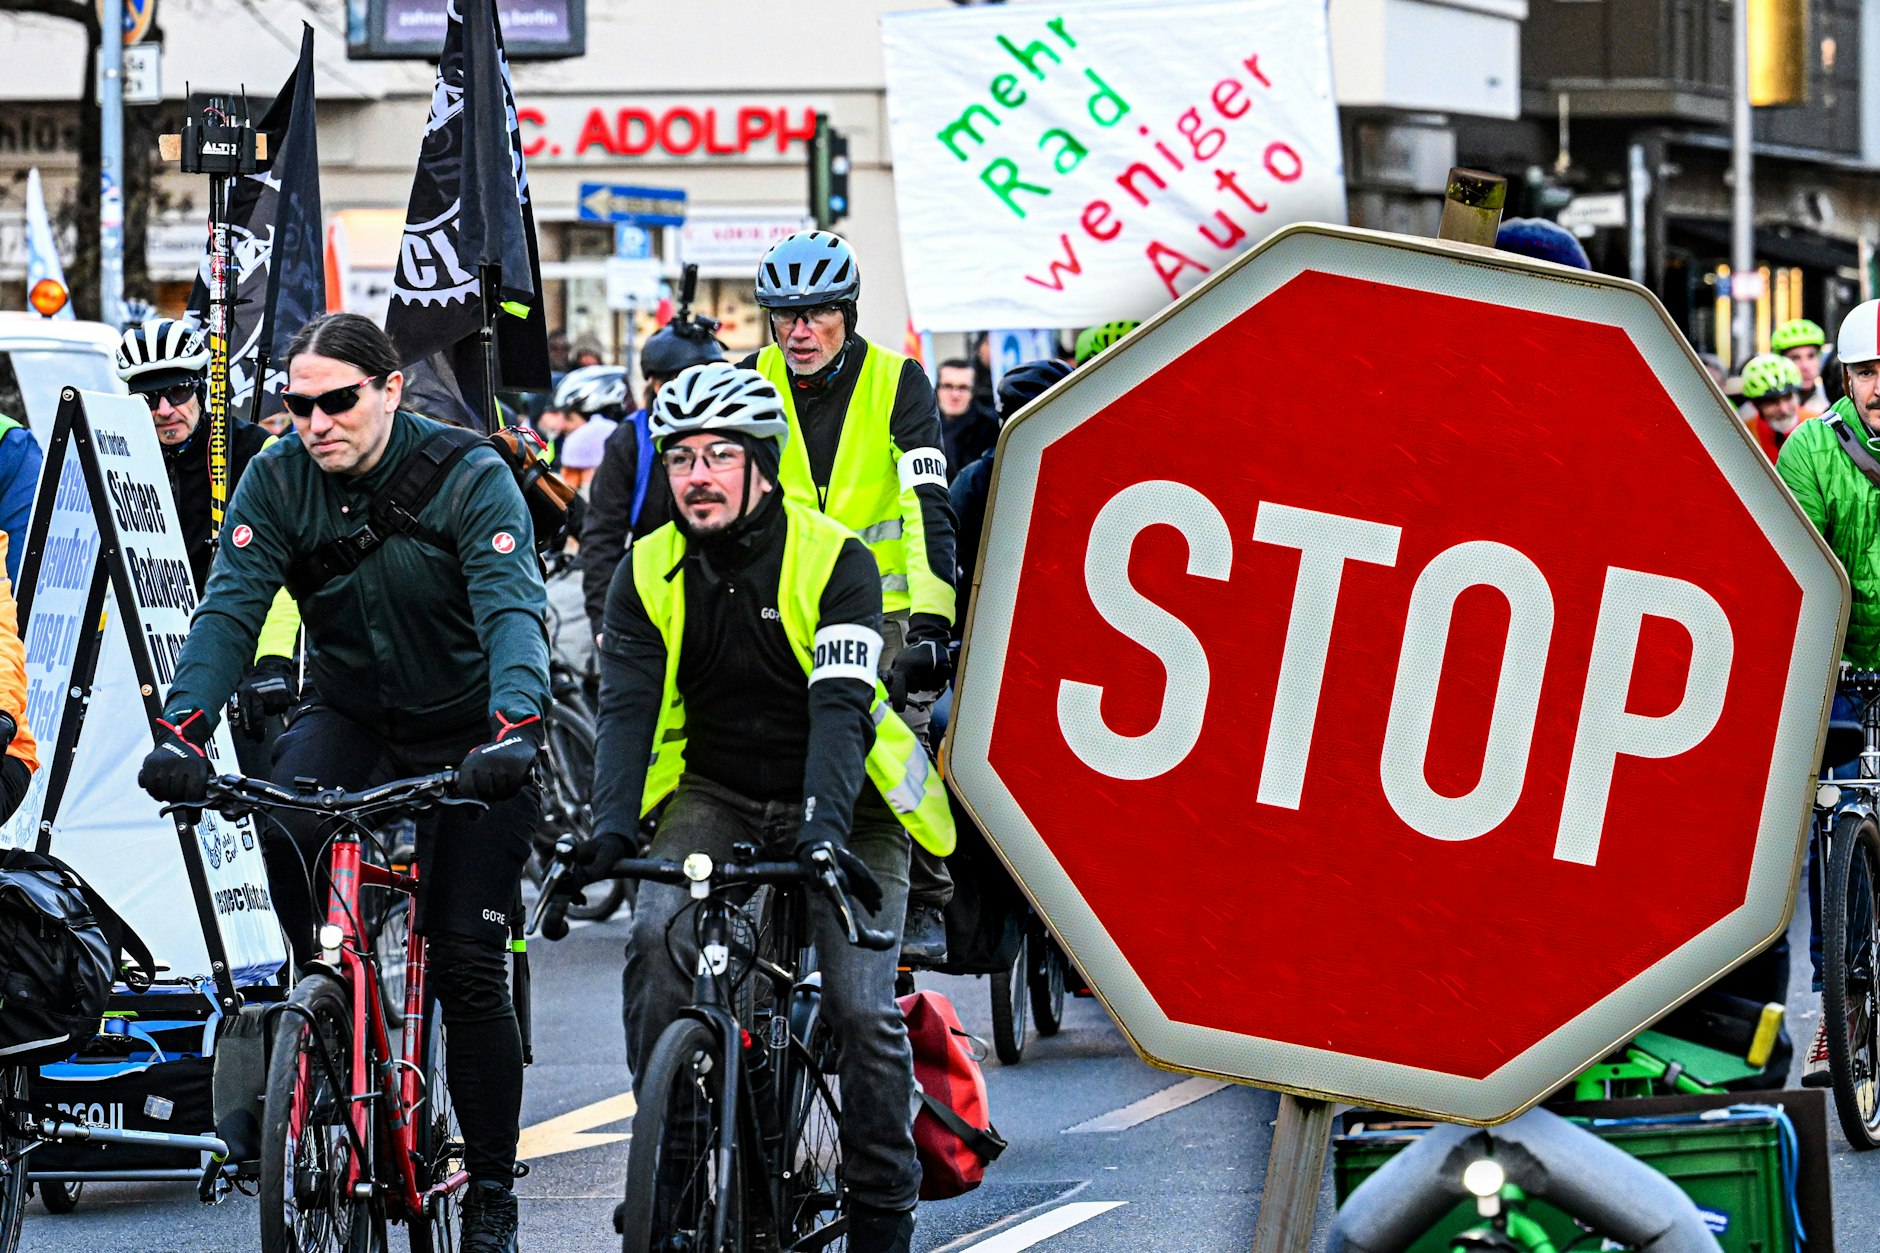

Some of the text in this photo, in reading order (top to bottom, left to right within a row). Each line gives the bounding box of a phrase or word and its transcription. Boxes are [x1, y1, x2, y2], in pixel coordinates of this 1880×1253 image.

[937, 17, 1077, 162] mehr
[576, 106, 817, 156] ADOLPH
[980, 67, 1131, 218] Rad
[1025, 53, 1272, 291] weniger
[1145, 141, 1304, 300] Auto
[94, 429, 107, 455] Wir
[106, 469, 167, 534] Sichere
[126, 547, 196, 617] Radwege
[145, 623, 173, 685] in
[1057, 479, 1735, 867] STOP
[482, 908, 506, 925] GORE
